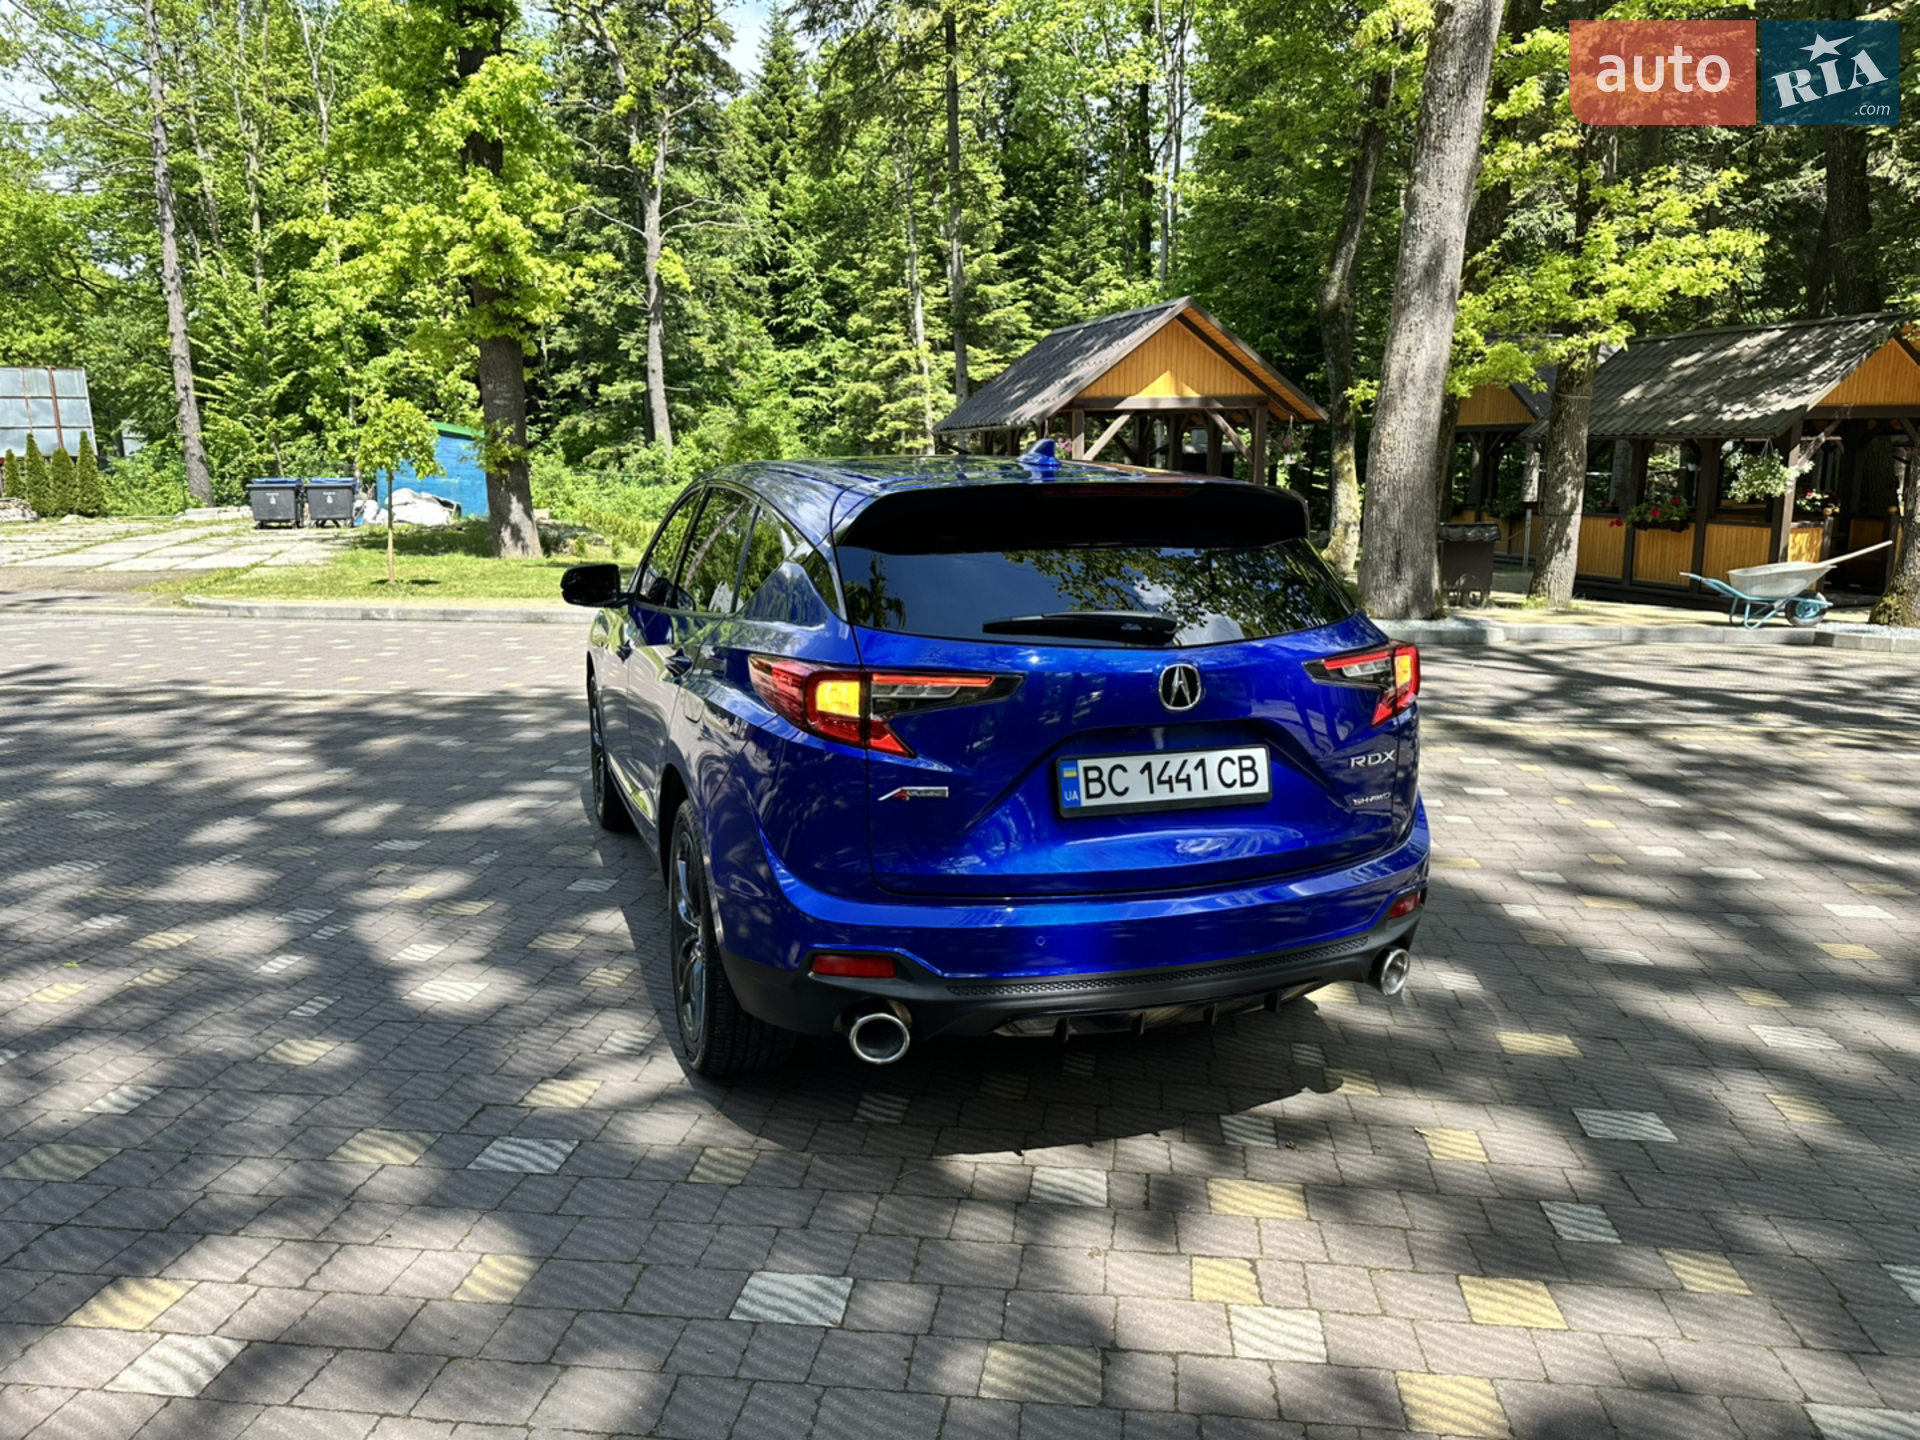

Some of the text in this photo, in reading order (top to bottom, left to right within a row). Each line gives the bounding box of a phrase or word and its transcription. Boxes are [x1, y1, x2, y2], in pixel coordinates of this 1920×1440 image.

[1350, 749, 1395, 768] RDX
[1082, 755, 1259, 800] BC 1441 CB
[1064, 790, 1080, 802] UA
